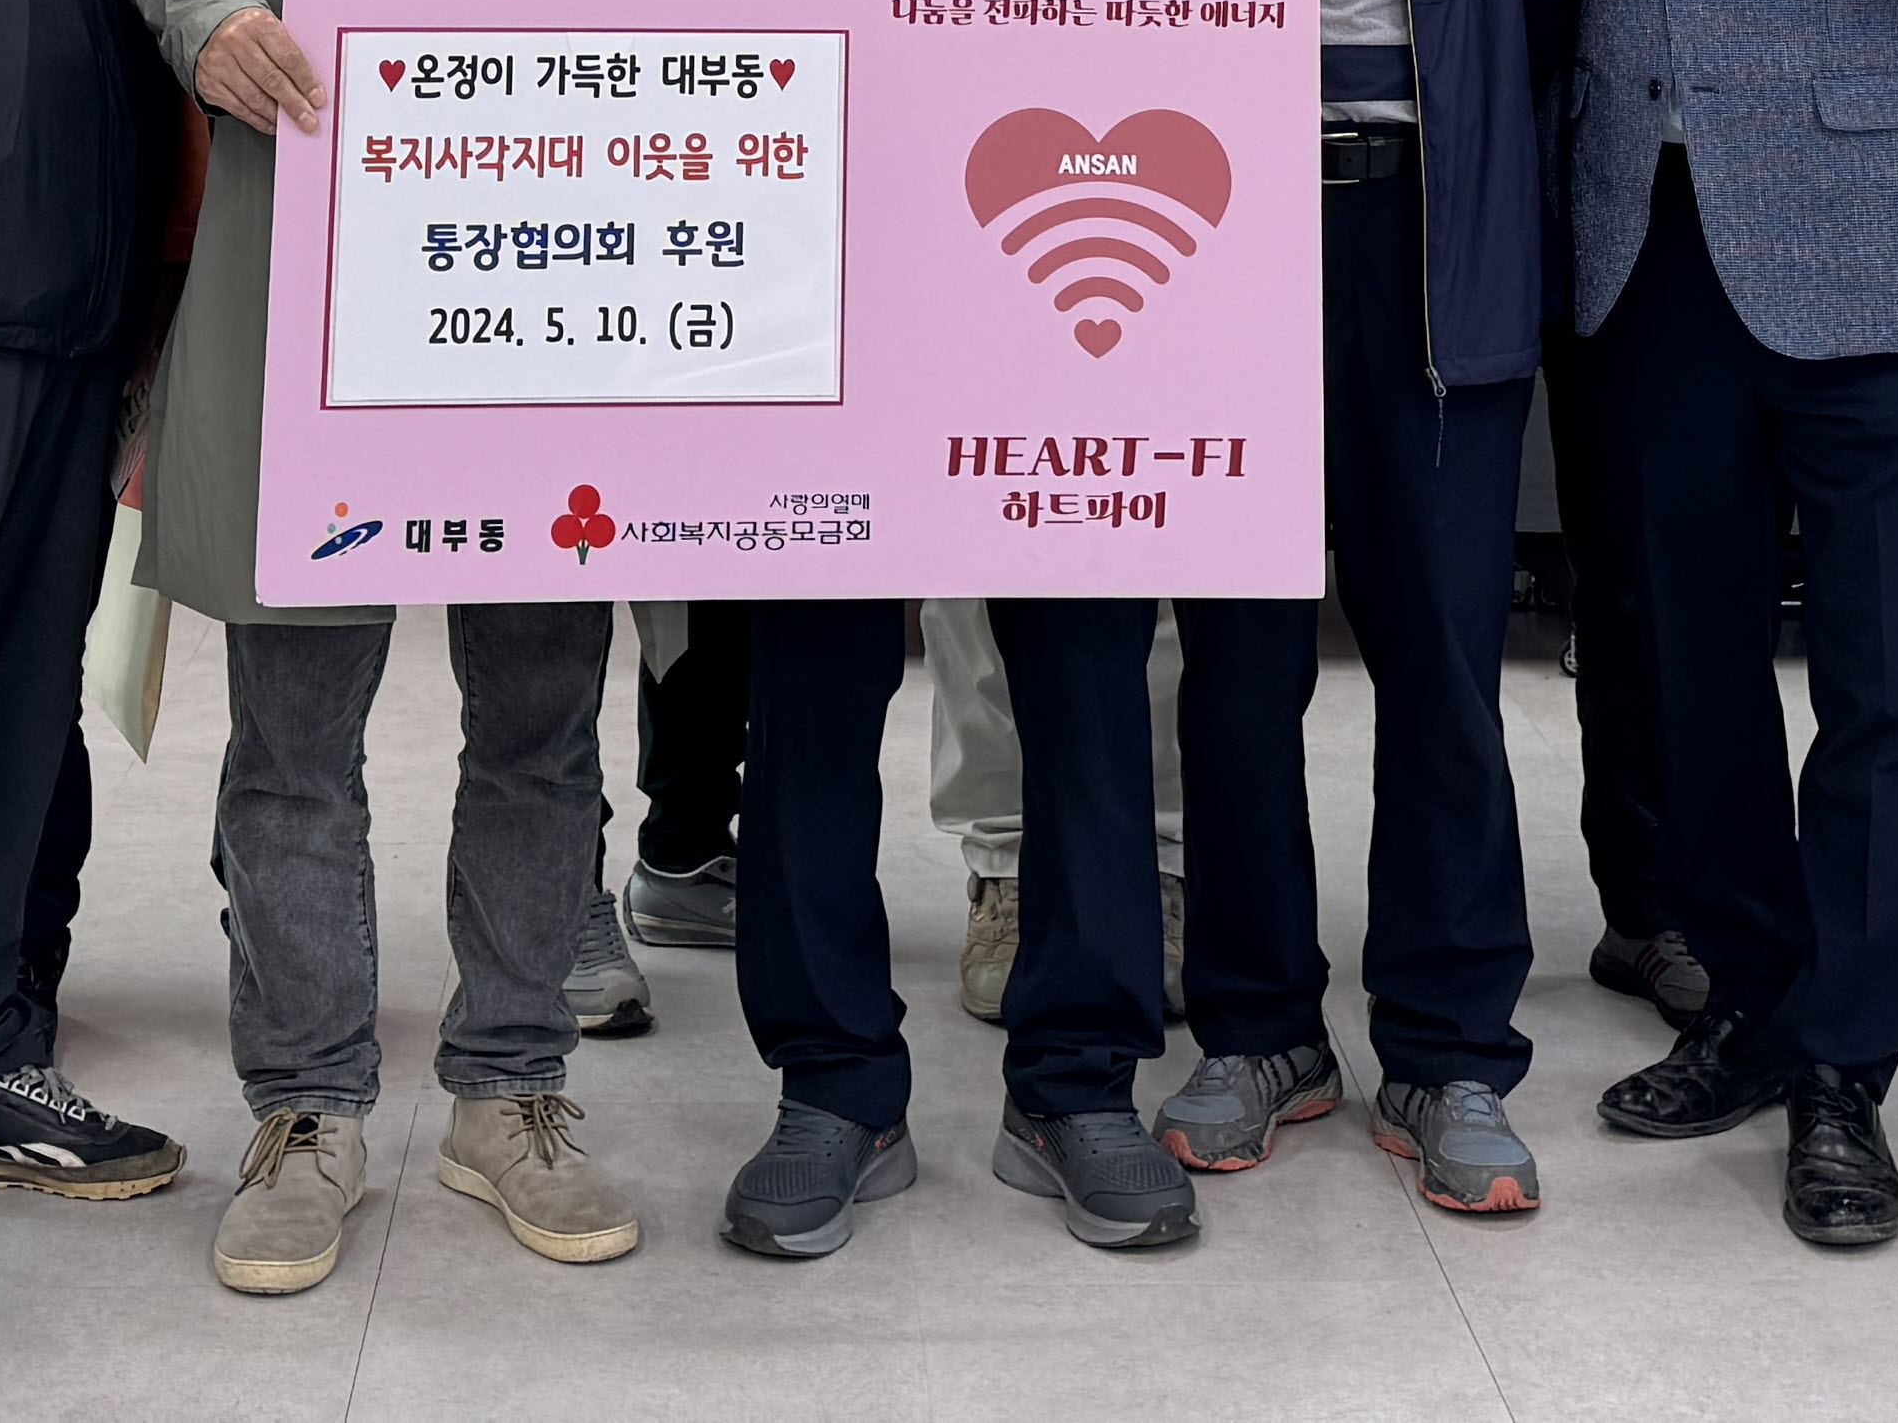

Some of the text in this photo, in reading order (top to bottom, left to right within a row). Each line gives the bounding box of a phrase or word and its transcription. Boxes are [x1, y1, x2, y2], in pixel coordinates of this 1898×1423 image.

[1106, 0, 1193, 27] 따듯한
[1201, 1, 1284, 28] 에너지
[411, 52, 764, 99] 온정이 가득한 대부동
[362, 132, 808, 182] 복지사각지대 이웃을 위한
[1059, 154, 1136, 175] ANSAN
[422, 220, 744, 271] 통장협의회 후원
[429, 301, 733, 350] 2024. 5. 10. (금)
[948, 437, 1246, 477] HEART-FI
[770, 493, 870, 512] 사랑의열매
[1002, 491, 1165, 528] 하트파이
[621, 517, 871, 551] 사회복지공동모금회
